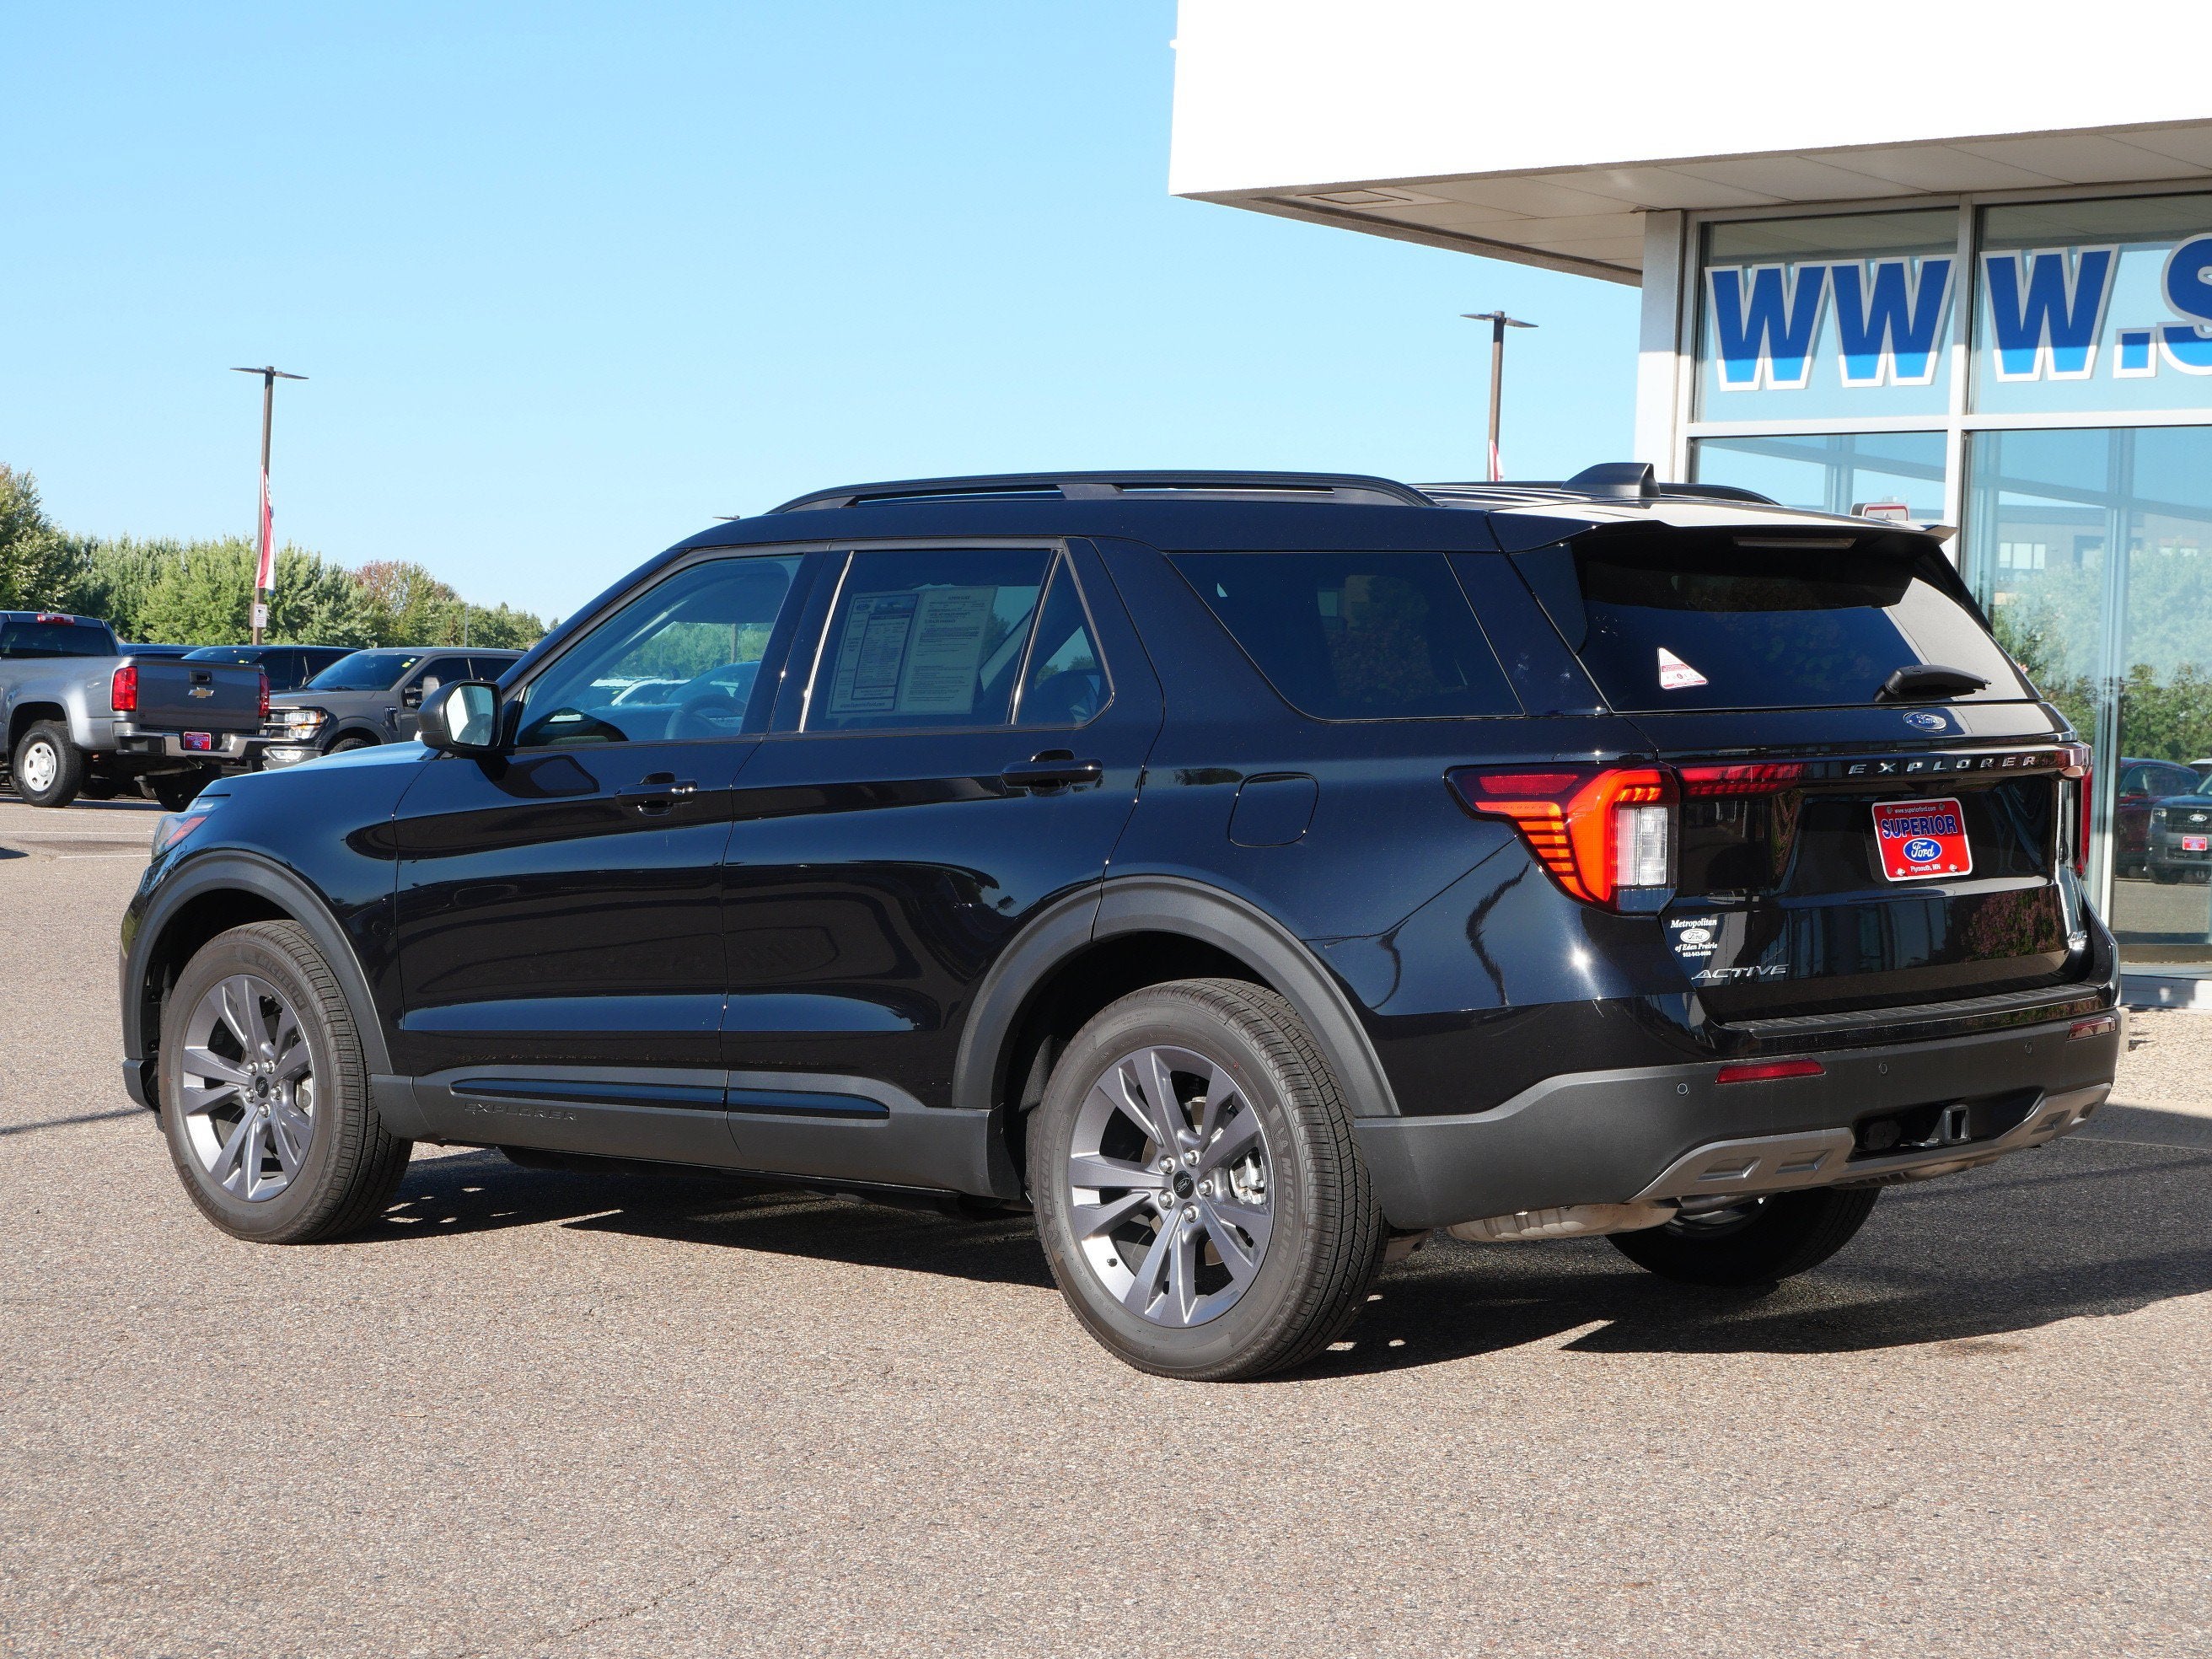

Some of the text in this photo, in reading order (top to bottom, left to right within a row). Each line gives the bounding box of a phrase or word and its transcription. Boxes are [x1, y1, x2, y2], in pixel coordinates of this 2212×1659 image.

[1848, 755, 2037, 775] EXPLORER
[1881, 814, 1958, 840] SUPERIOR
[1910, 841, 1935, 858] Ford
[1670, 918, 1717, 929] Metropolitan
[1690, 964, 1790, 980] ACTIVE
[464, 1103, 577, 1121] EXPLORER
[1279, 1157, 1295, 1264] MICHELIN
